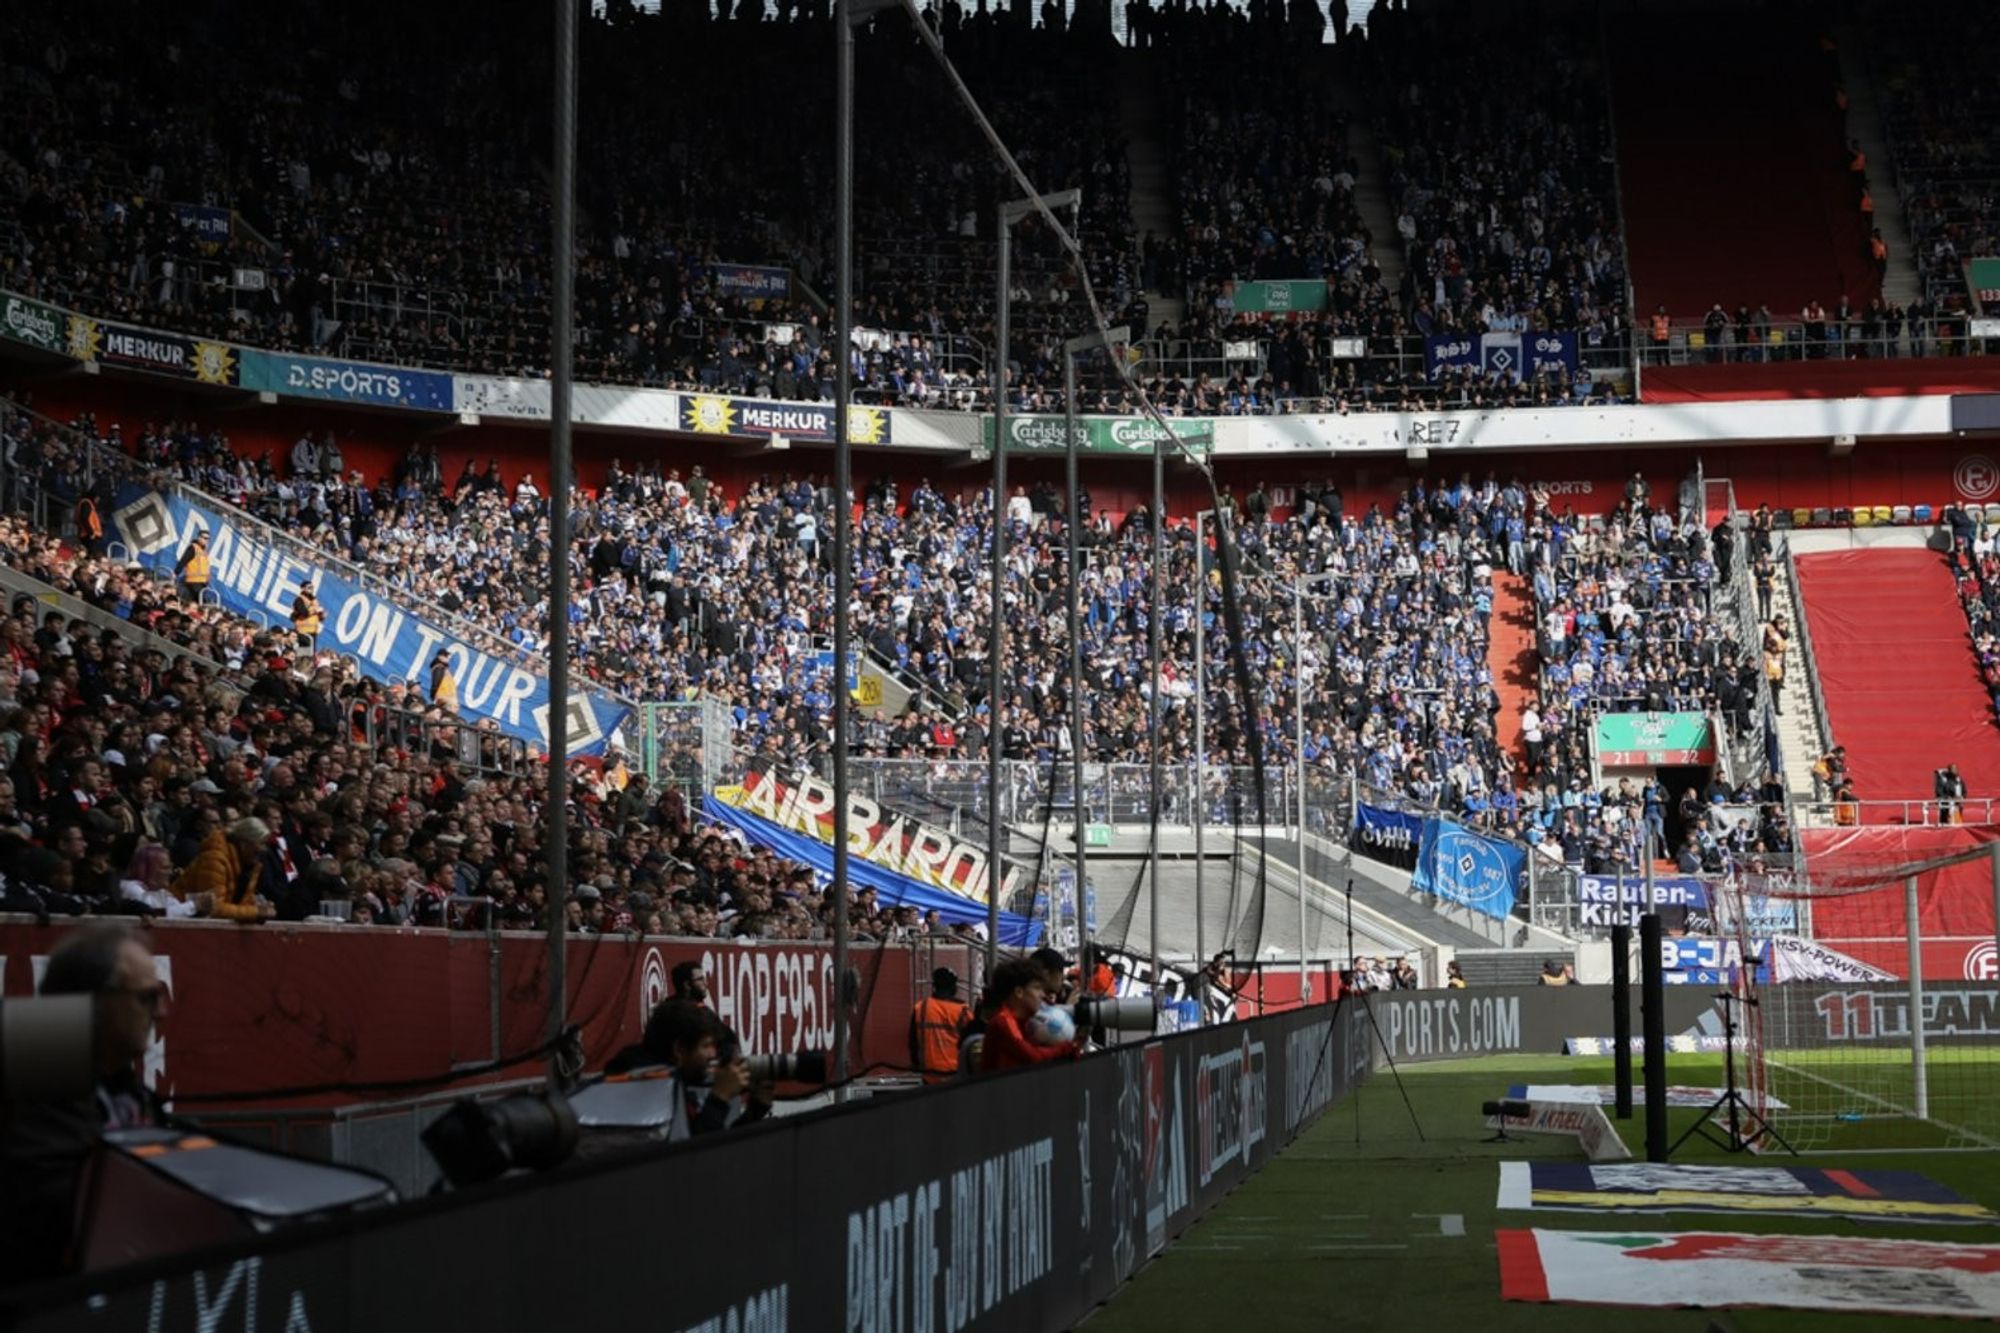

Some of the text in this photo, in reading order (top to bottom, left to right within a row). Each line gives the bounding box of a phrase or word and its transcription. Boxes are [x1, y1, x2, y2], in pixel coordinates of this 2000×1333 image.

[6, 299, 56, 341] Carlsberg
[107, 333, 185, 366] MERKUR
[742, 409, 827, 430] MERKUR
[1011, 418, 1088, 443] Carlsbeg
[335, 593, 404, 666] ON
[405, 623, 537, 727] TOUR
